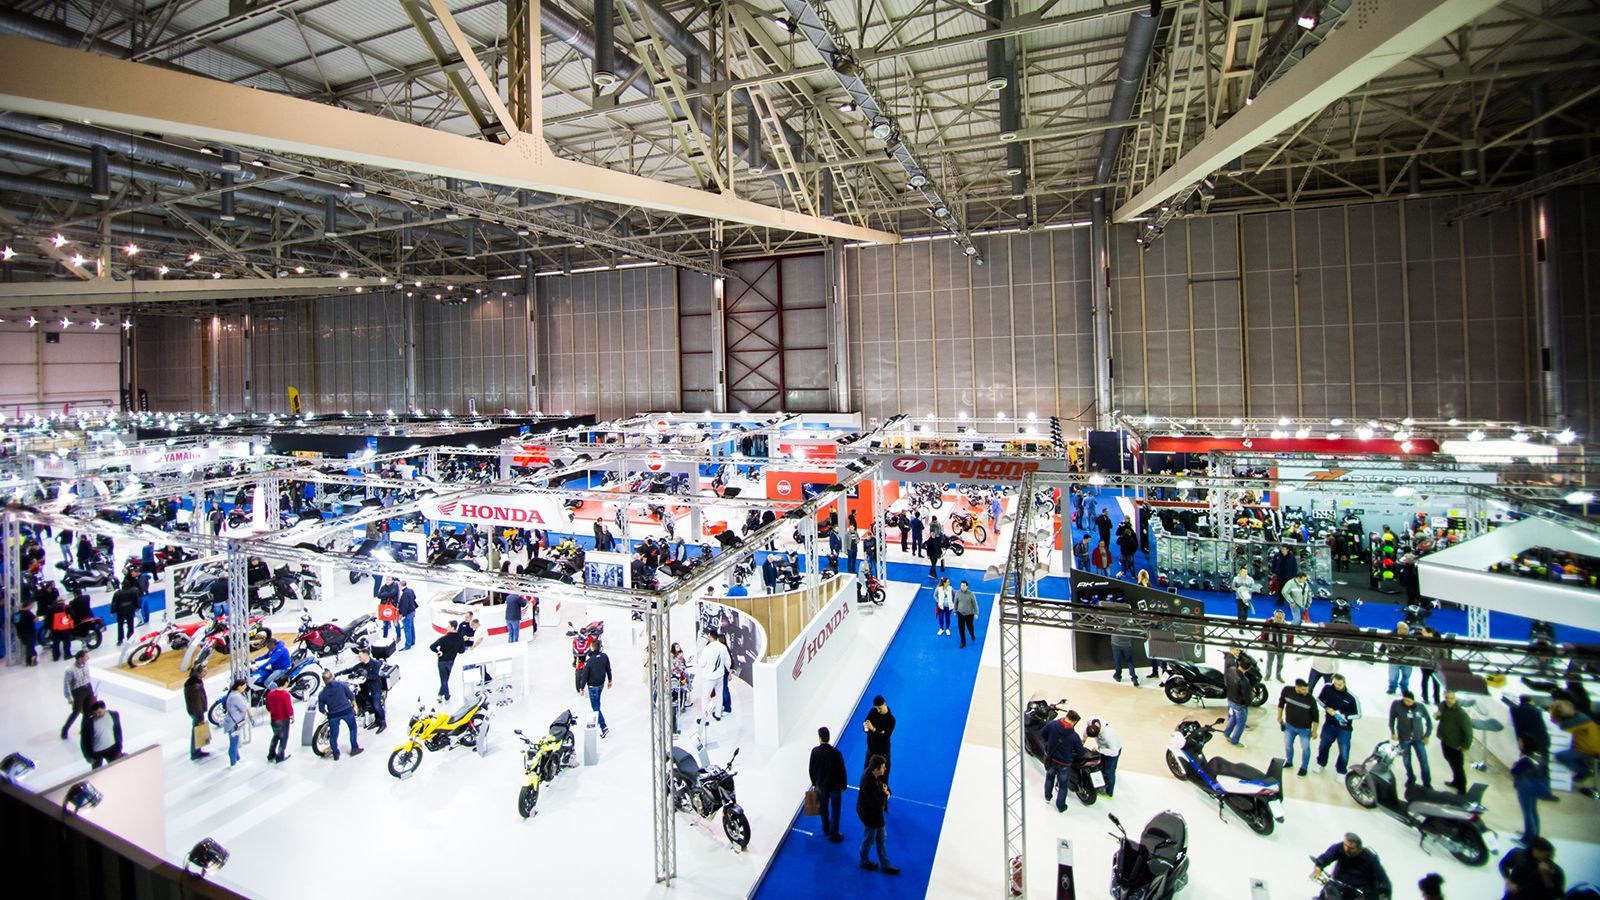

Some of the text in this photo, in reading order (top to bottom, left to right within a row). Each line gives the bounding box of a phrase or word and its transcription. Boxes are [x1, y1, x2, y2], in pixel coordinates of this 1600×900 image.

[929, 457, 1040, 479] Daytona
[460, 503, 546, 525] HONDA
[807, 601, 850, 664] HONDA
